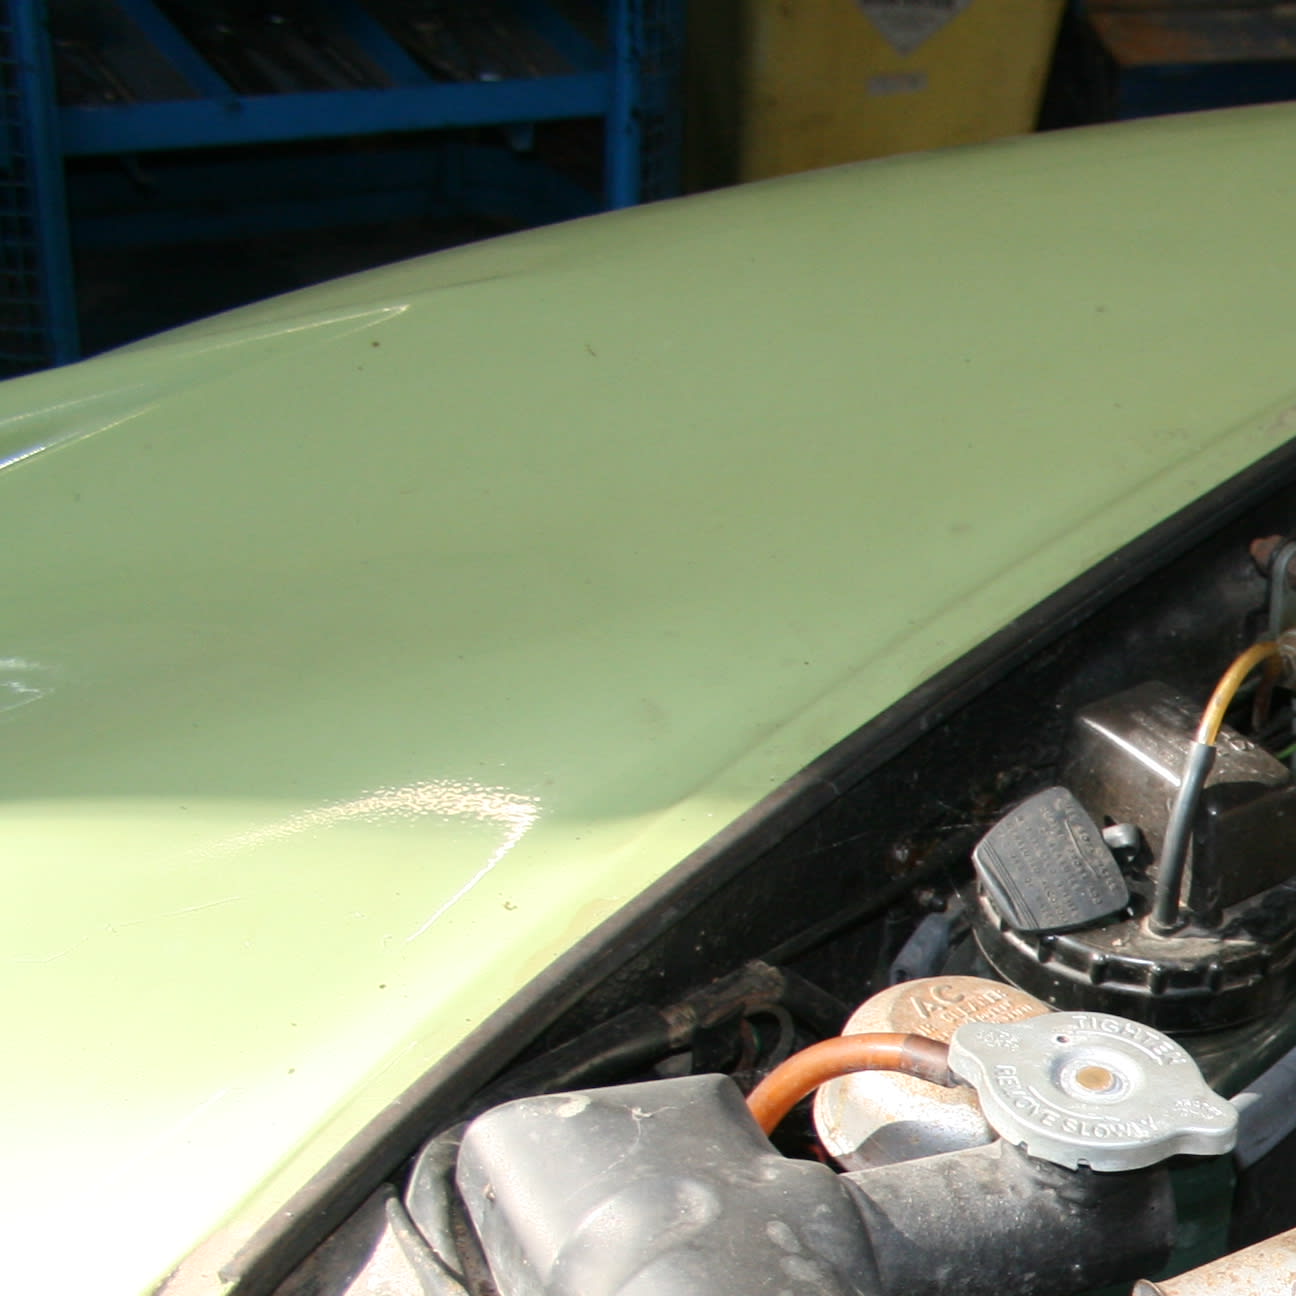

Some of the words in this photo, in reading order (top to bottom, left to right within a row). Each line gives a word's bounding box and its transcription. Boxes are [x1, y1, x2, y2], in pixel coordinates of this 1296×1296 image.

[910, 985, 965, 1018] AC
[1072, 1015, 1187, 1067] TIGHTEN
[994, 1064, 1061, 1126] REMOVE
[1062, 1114, 1158, 1138] SLOWLY
